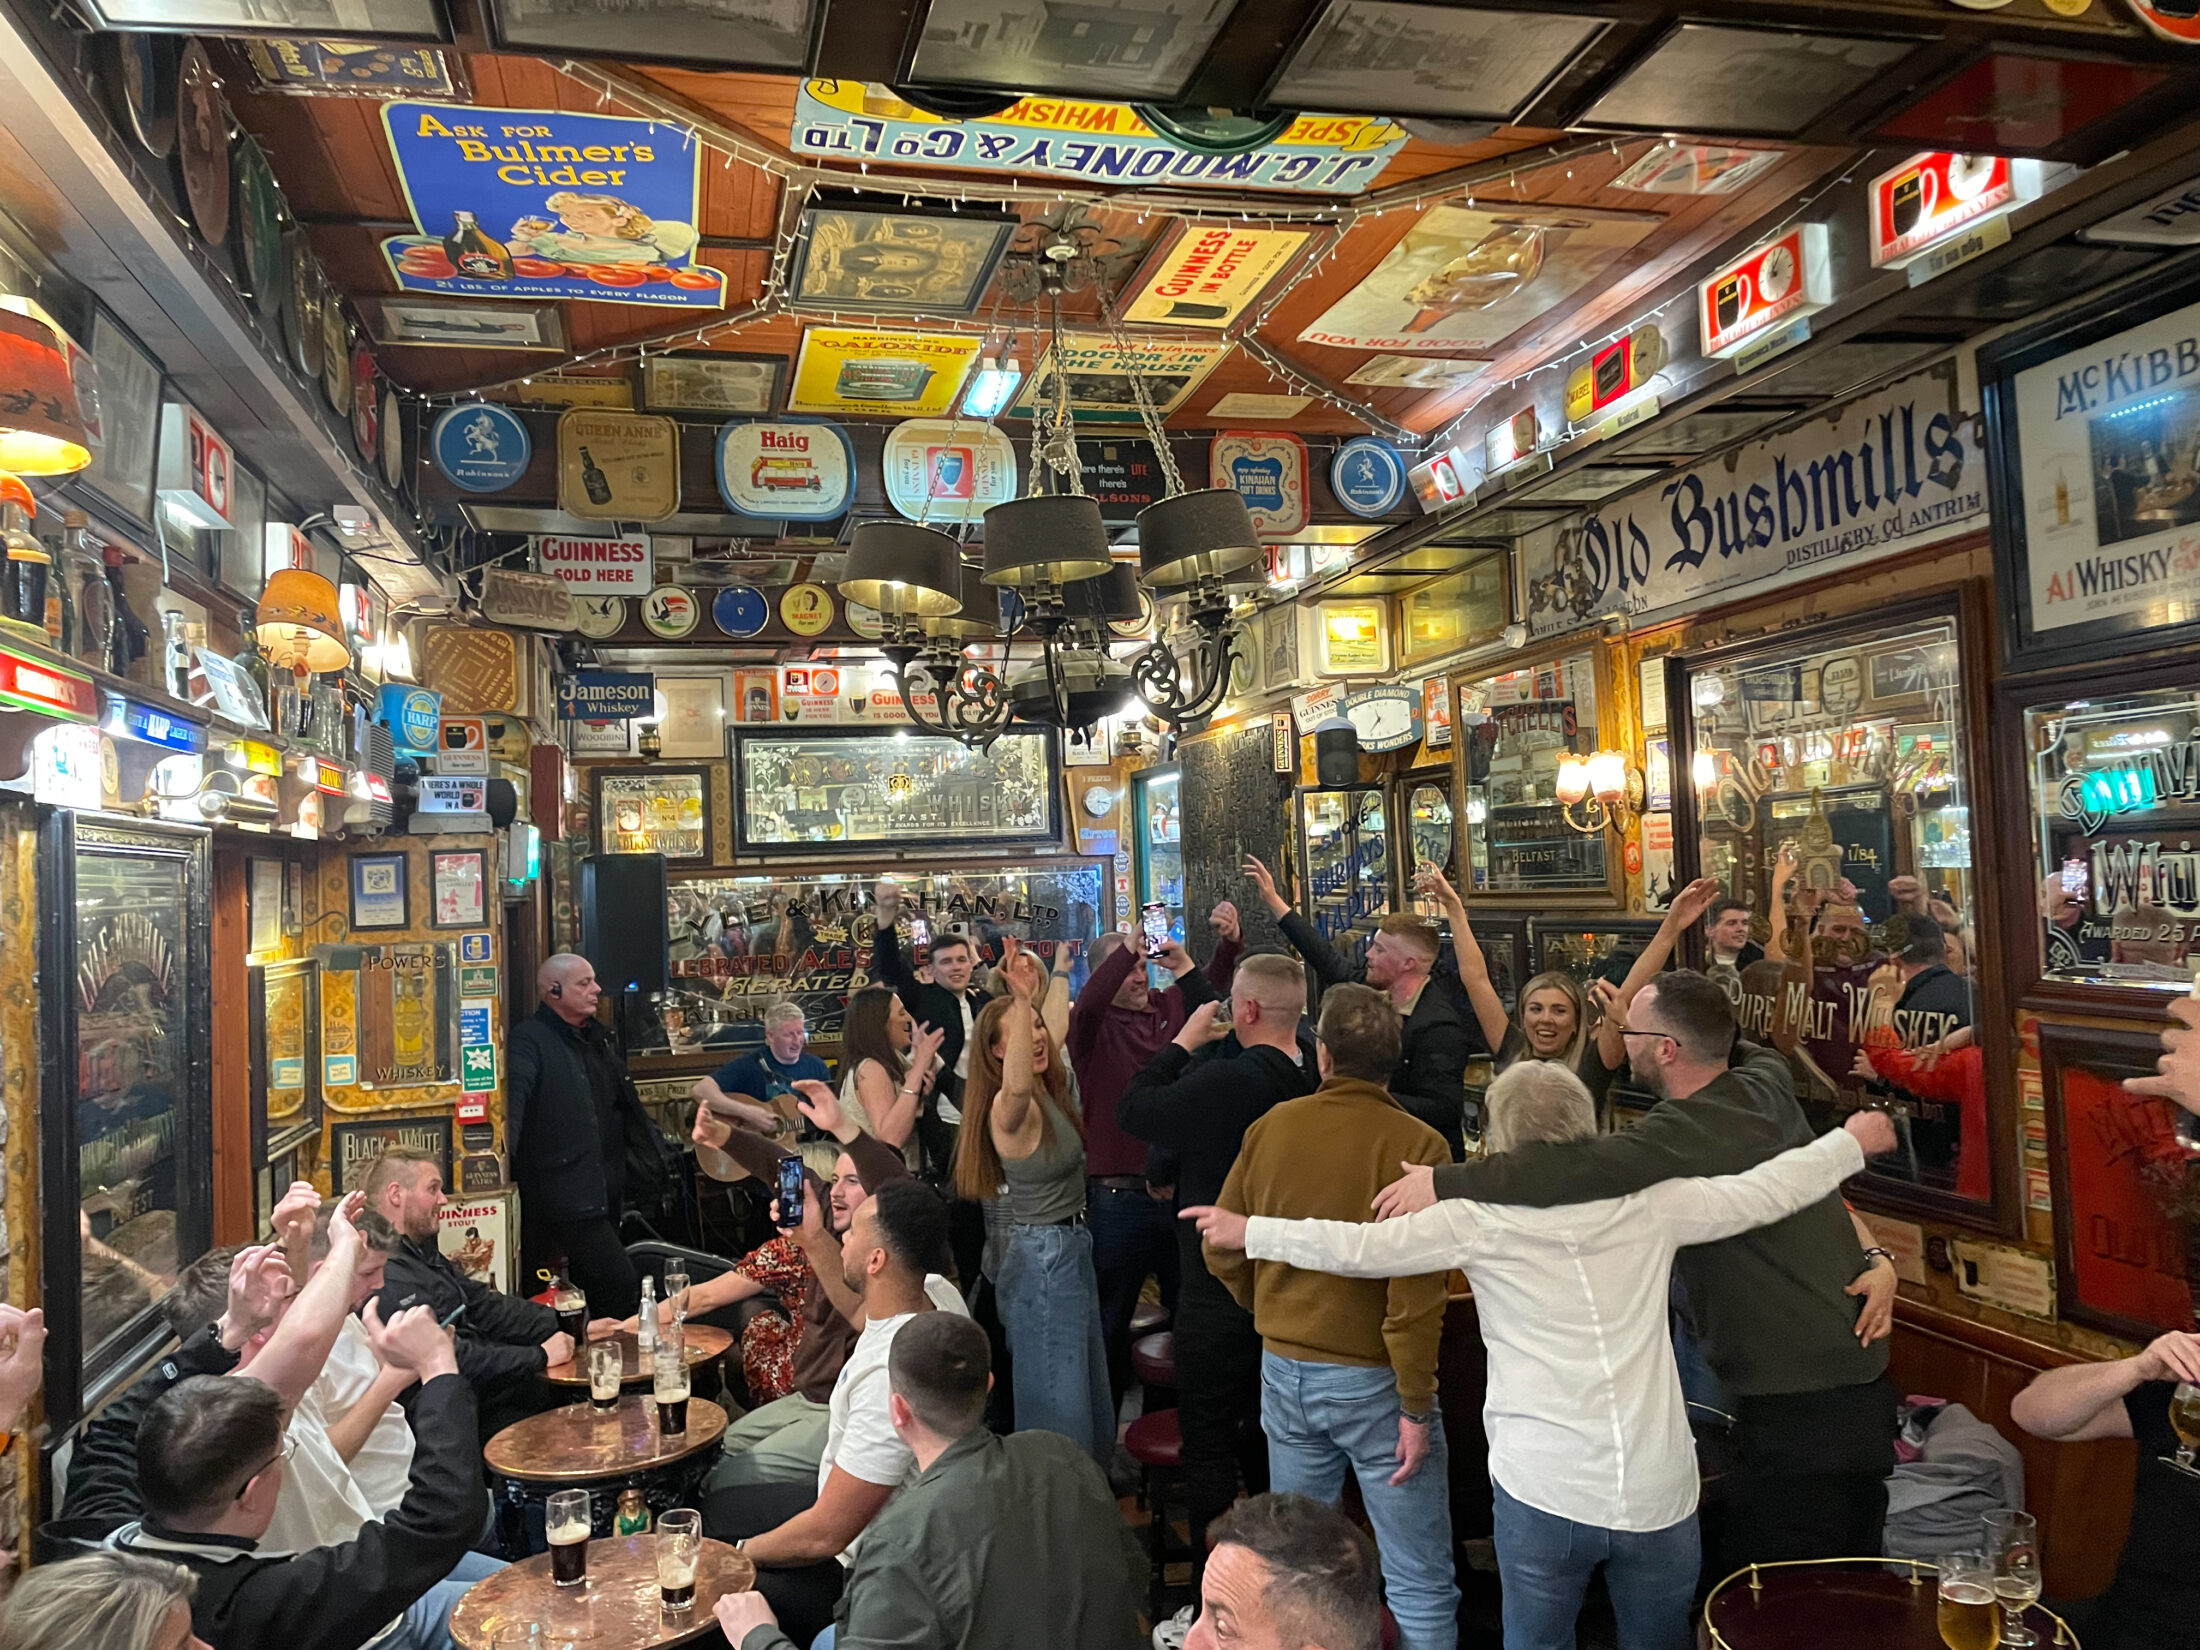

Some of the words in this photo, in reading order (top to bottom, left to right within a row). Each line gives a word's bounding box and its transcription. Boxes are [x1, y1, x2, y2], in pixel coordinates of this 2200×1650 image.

[1012, 101, 1116, 133] WHISK
[502, 125, 552, 138] FOR
[458, 139, 655, 163] Bulmer's
[973, 133, 1018, 161] &
[497, 165, 626, 186] Cider
[1155, 229, 1234, 298] GUINNESS
[1199, 280, 1220, 295] IN
[1211, 239, 1258, 281] BOTTLE
[490, 285, 508, 293] OF
[513, 285, 562, 295] APPLES
[567, 288, 584, 296] TO
[590, 289, 631, 298] EVERY
[635, 292, 688, 302] FLAGON
[1310, 332, 1350, 343] YOU
[1364, 336, 1403, 349] FOR
[1177, 353, 1207, 363] IN
[575, 423, 622, 438] QUEEN
[625, 425, 664, 439] ANNE
[760, 431, 810, 452] Haig
[1239, 476, 1276, 487] KINAHAN
[1094, 494, 1151, 503] LSONS
[1581, 511, 1651, 602] Old
[1661, 400, 1965, 574] Bushmills
[1909, 491, 1982, 529] ANTRIM
[542, 537, 645, 563] GUINNESS
[554, 568, 592, 582] SOLD
[596, 569, 634, 583] HERE
[2075, 546, 2174, 597] WHISKY
[792, 612, 823, 620] MAGNET
[560, 680, 651, 702] Jameson
[872, 693, 936, 706] GUINESS
[1305, 688, 1332, 704] SORRY
[1345, 690, 1373, 709] DOUBLE
[1374, 688, 1411, 699] DIAMOND
[586, 702, 640, 715] Whiskey
[802, 699, 834, 707] GUINNESS
[1299, 696, 1342, 718] GUINNESS
[407, 711, 438, 728] HARP
[1305, 715, 1316, 724] OUT
[1316, 712, 1324, 720] OF
[577, 733, 626, 743] WOODBINE
[1358, 739, 1376, 751] ORKS
[1377, 732, 1414, 749] WONDERS
[451, 781, 458, 789] A
[459, 781, 484, 789] WHOLE
[434, 791, 460, 799] WORLD
[926, 794, 1027, 813] WHISKY
[445, 801, 453, 809] IN
[454, 801, 460, 810] A
[1512, 849, 1556, 864] BELFAST
[1847, 843, 1878, 869] 1784
[786, 897, 810, 919] &
[2079, 920, 2152, 943] AWARDED
[2157, 924, 2185, 943] 25
[670, 953, 790, 979] LEBRATED
[801, 947, 871, 971] ALES
[1725, 975, 1776, 1038] PURE
[1783, 981, 1839, 1045] MALT
[1841, 981, 1959, 1052] WHISKEY
[376, 1064, 445, 1082] WHISKEY
[345, 1132, 386, 1162] BLACK
[398, 1128, 440, 1155] WHITE
[437, 1205, 498, 1221] UINNESS
[448, 1219, 477, 1228] STOUT
